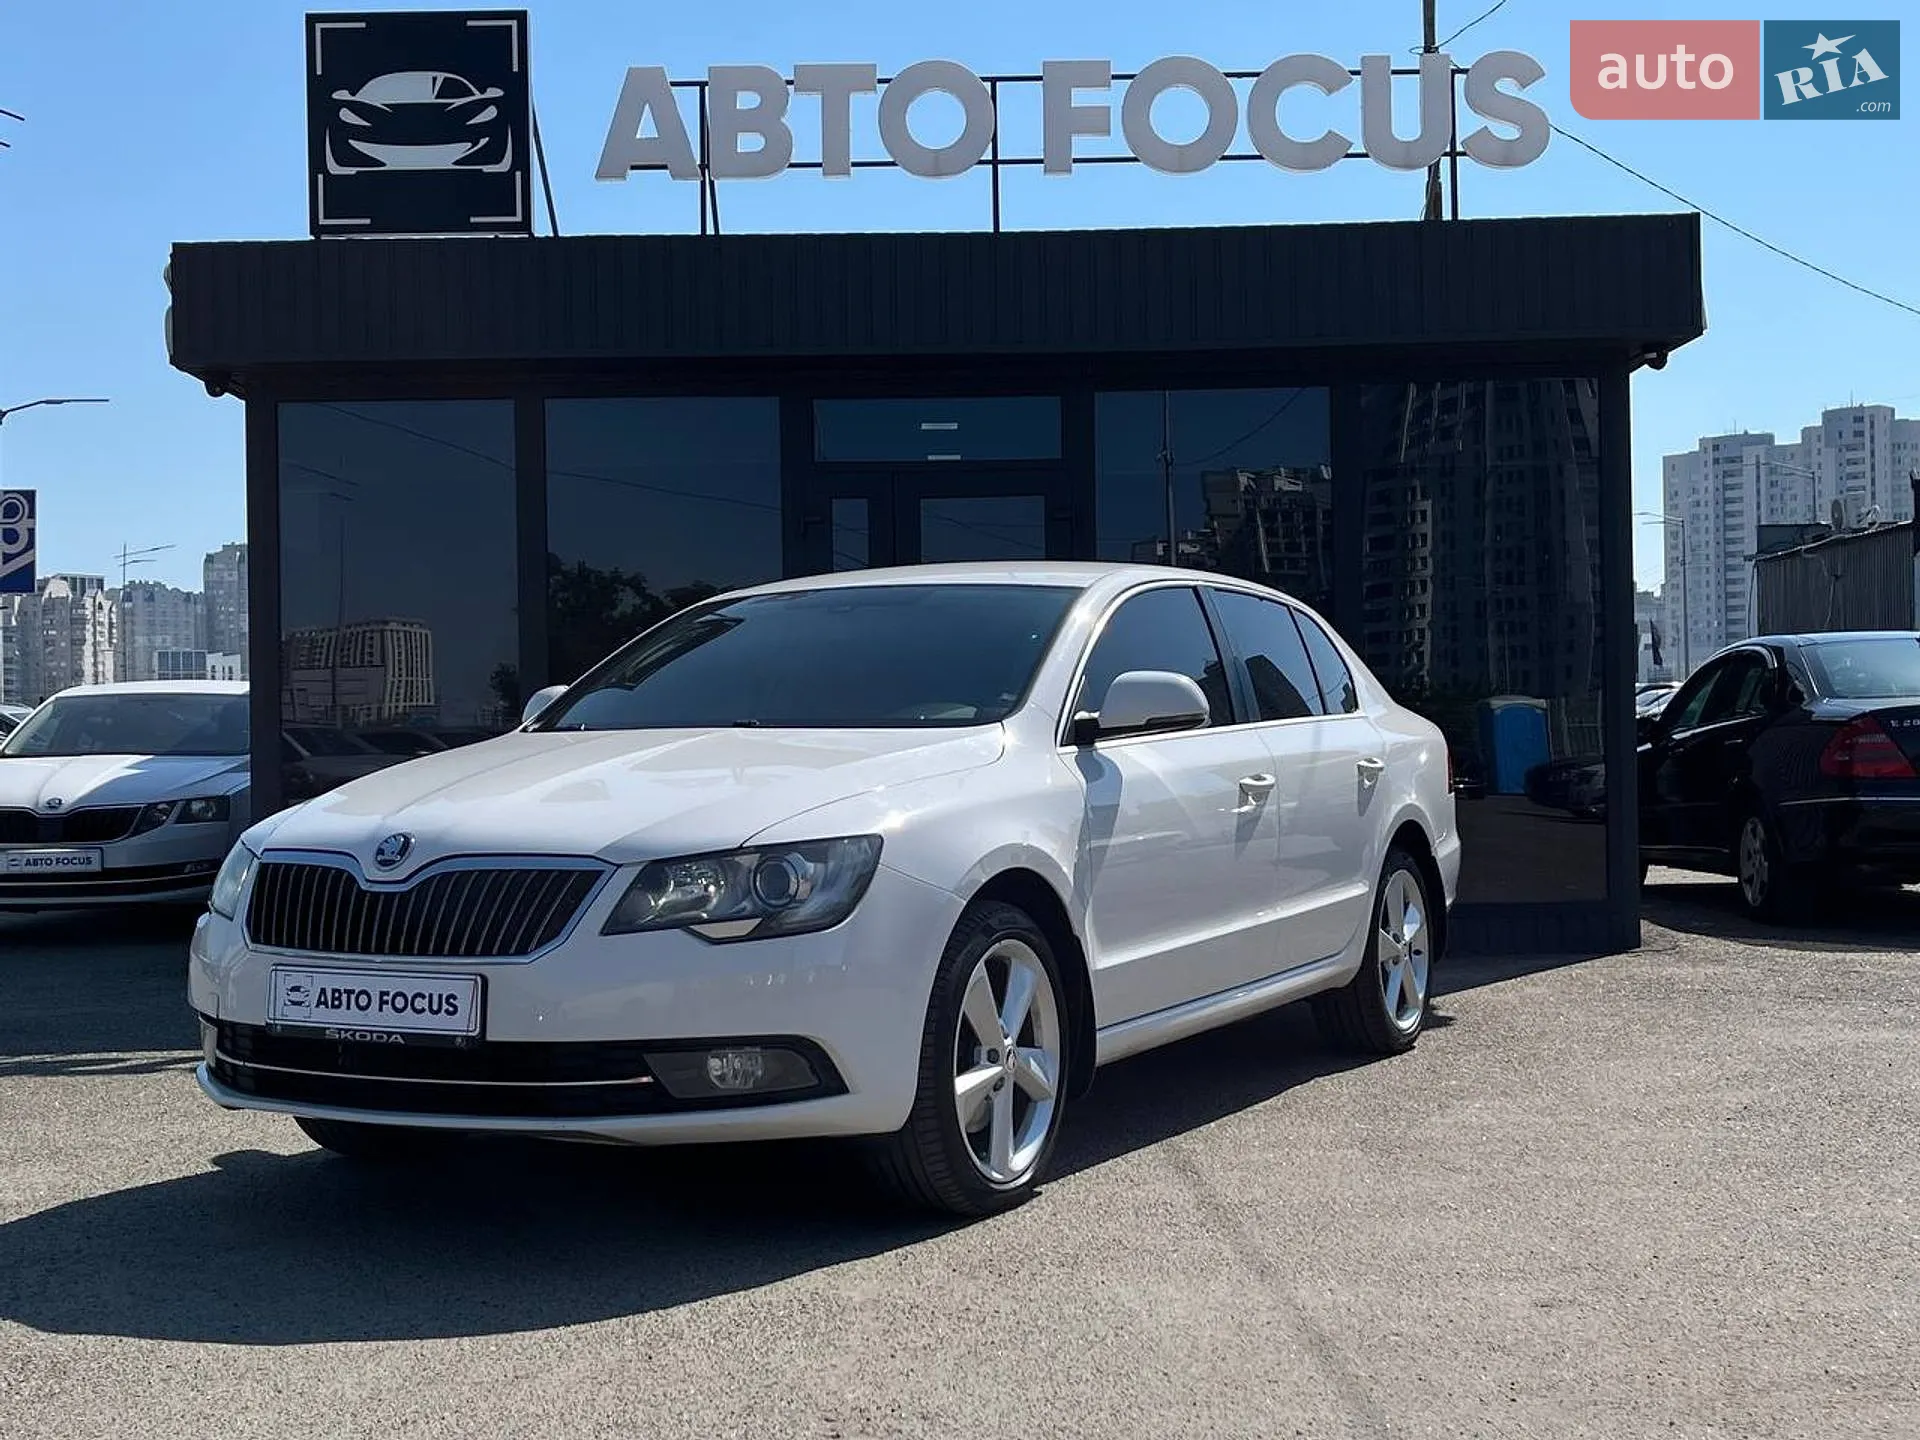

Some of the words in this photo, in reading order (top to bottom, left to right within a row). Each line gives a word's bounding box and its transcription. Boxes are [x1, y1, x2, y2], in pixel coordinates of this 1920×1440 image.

[594, 59, 995, 181] АВТО
[1042, 50, 1551, 176] FOCUS
[55, 856, 93, 866] FOCUS
[315, 987, 372, 1012] АВТО
[378, 990, 459, 1017] FOCUS
